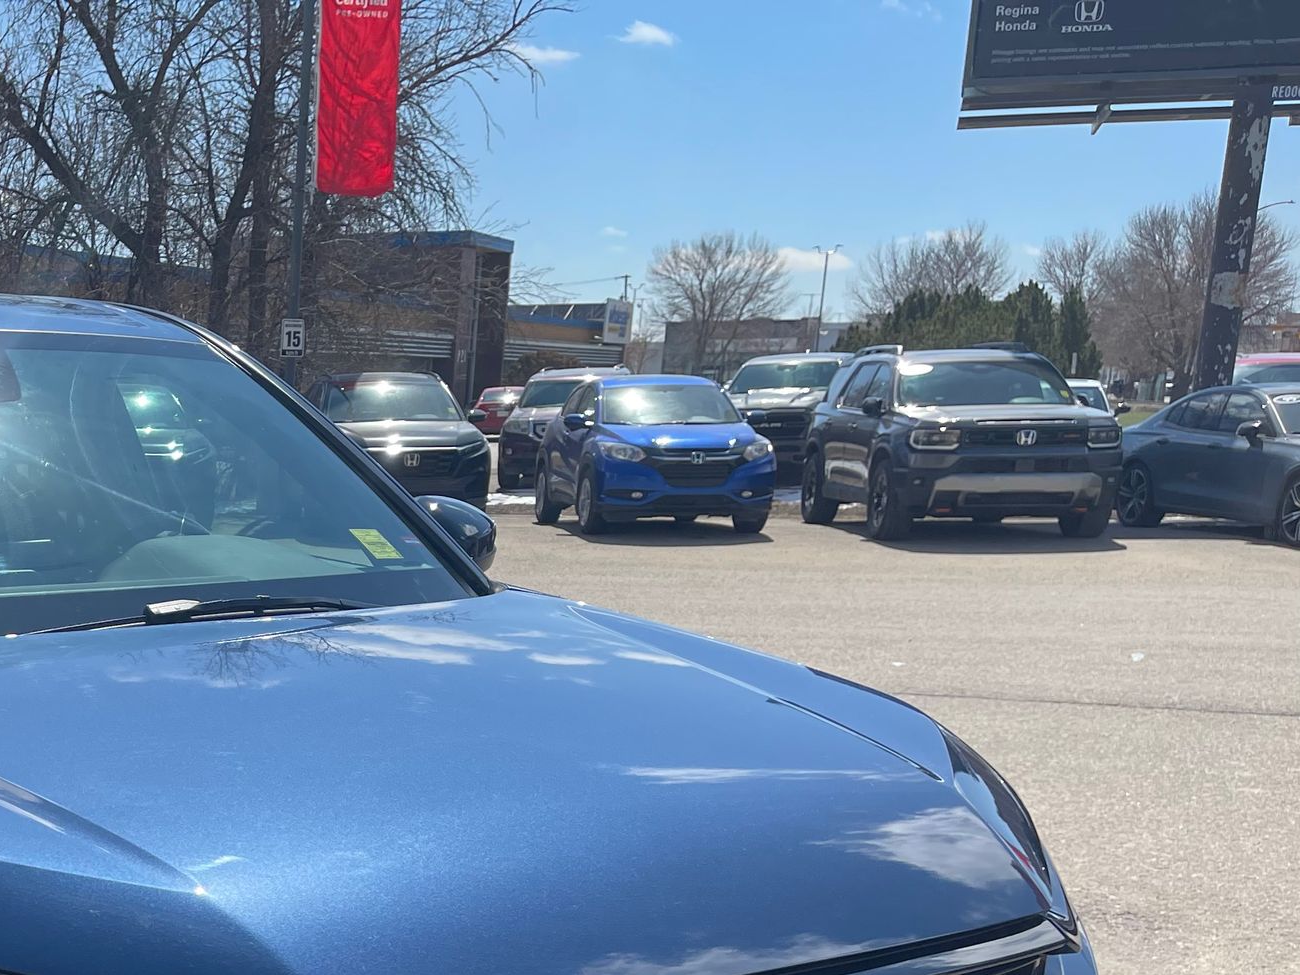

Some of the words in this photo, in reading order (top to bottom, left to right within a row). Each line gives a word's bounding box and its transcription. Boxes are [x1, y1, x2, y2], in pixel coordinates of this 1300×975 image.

[996, 4, 1040, 18] Regina
[995, 20, 1037, 32] Honda
[1061, 23, 1114, 33] HONDA
[285, 330, 301, 347] 15
